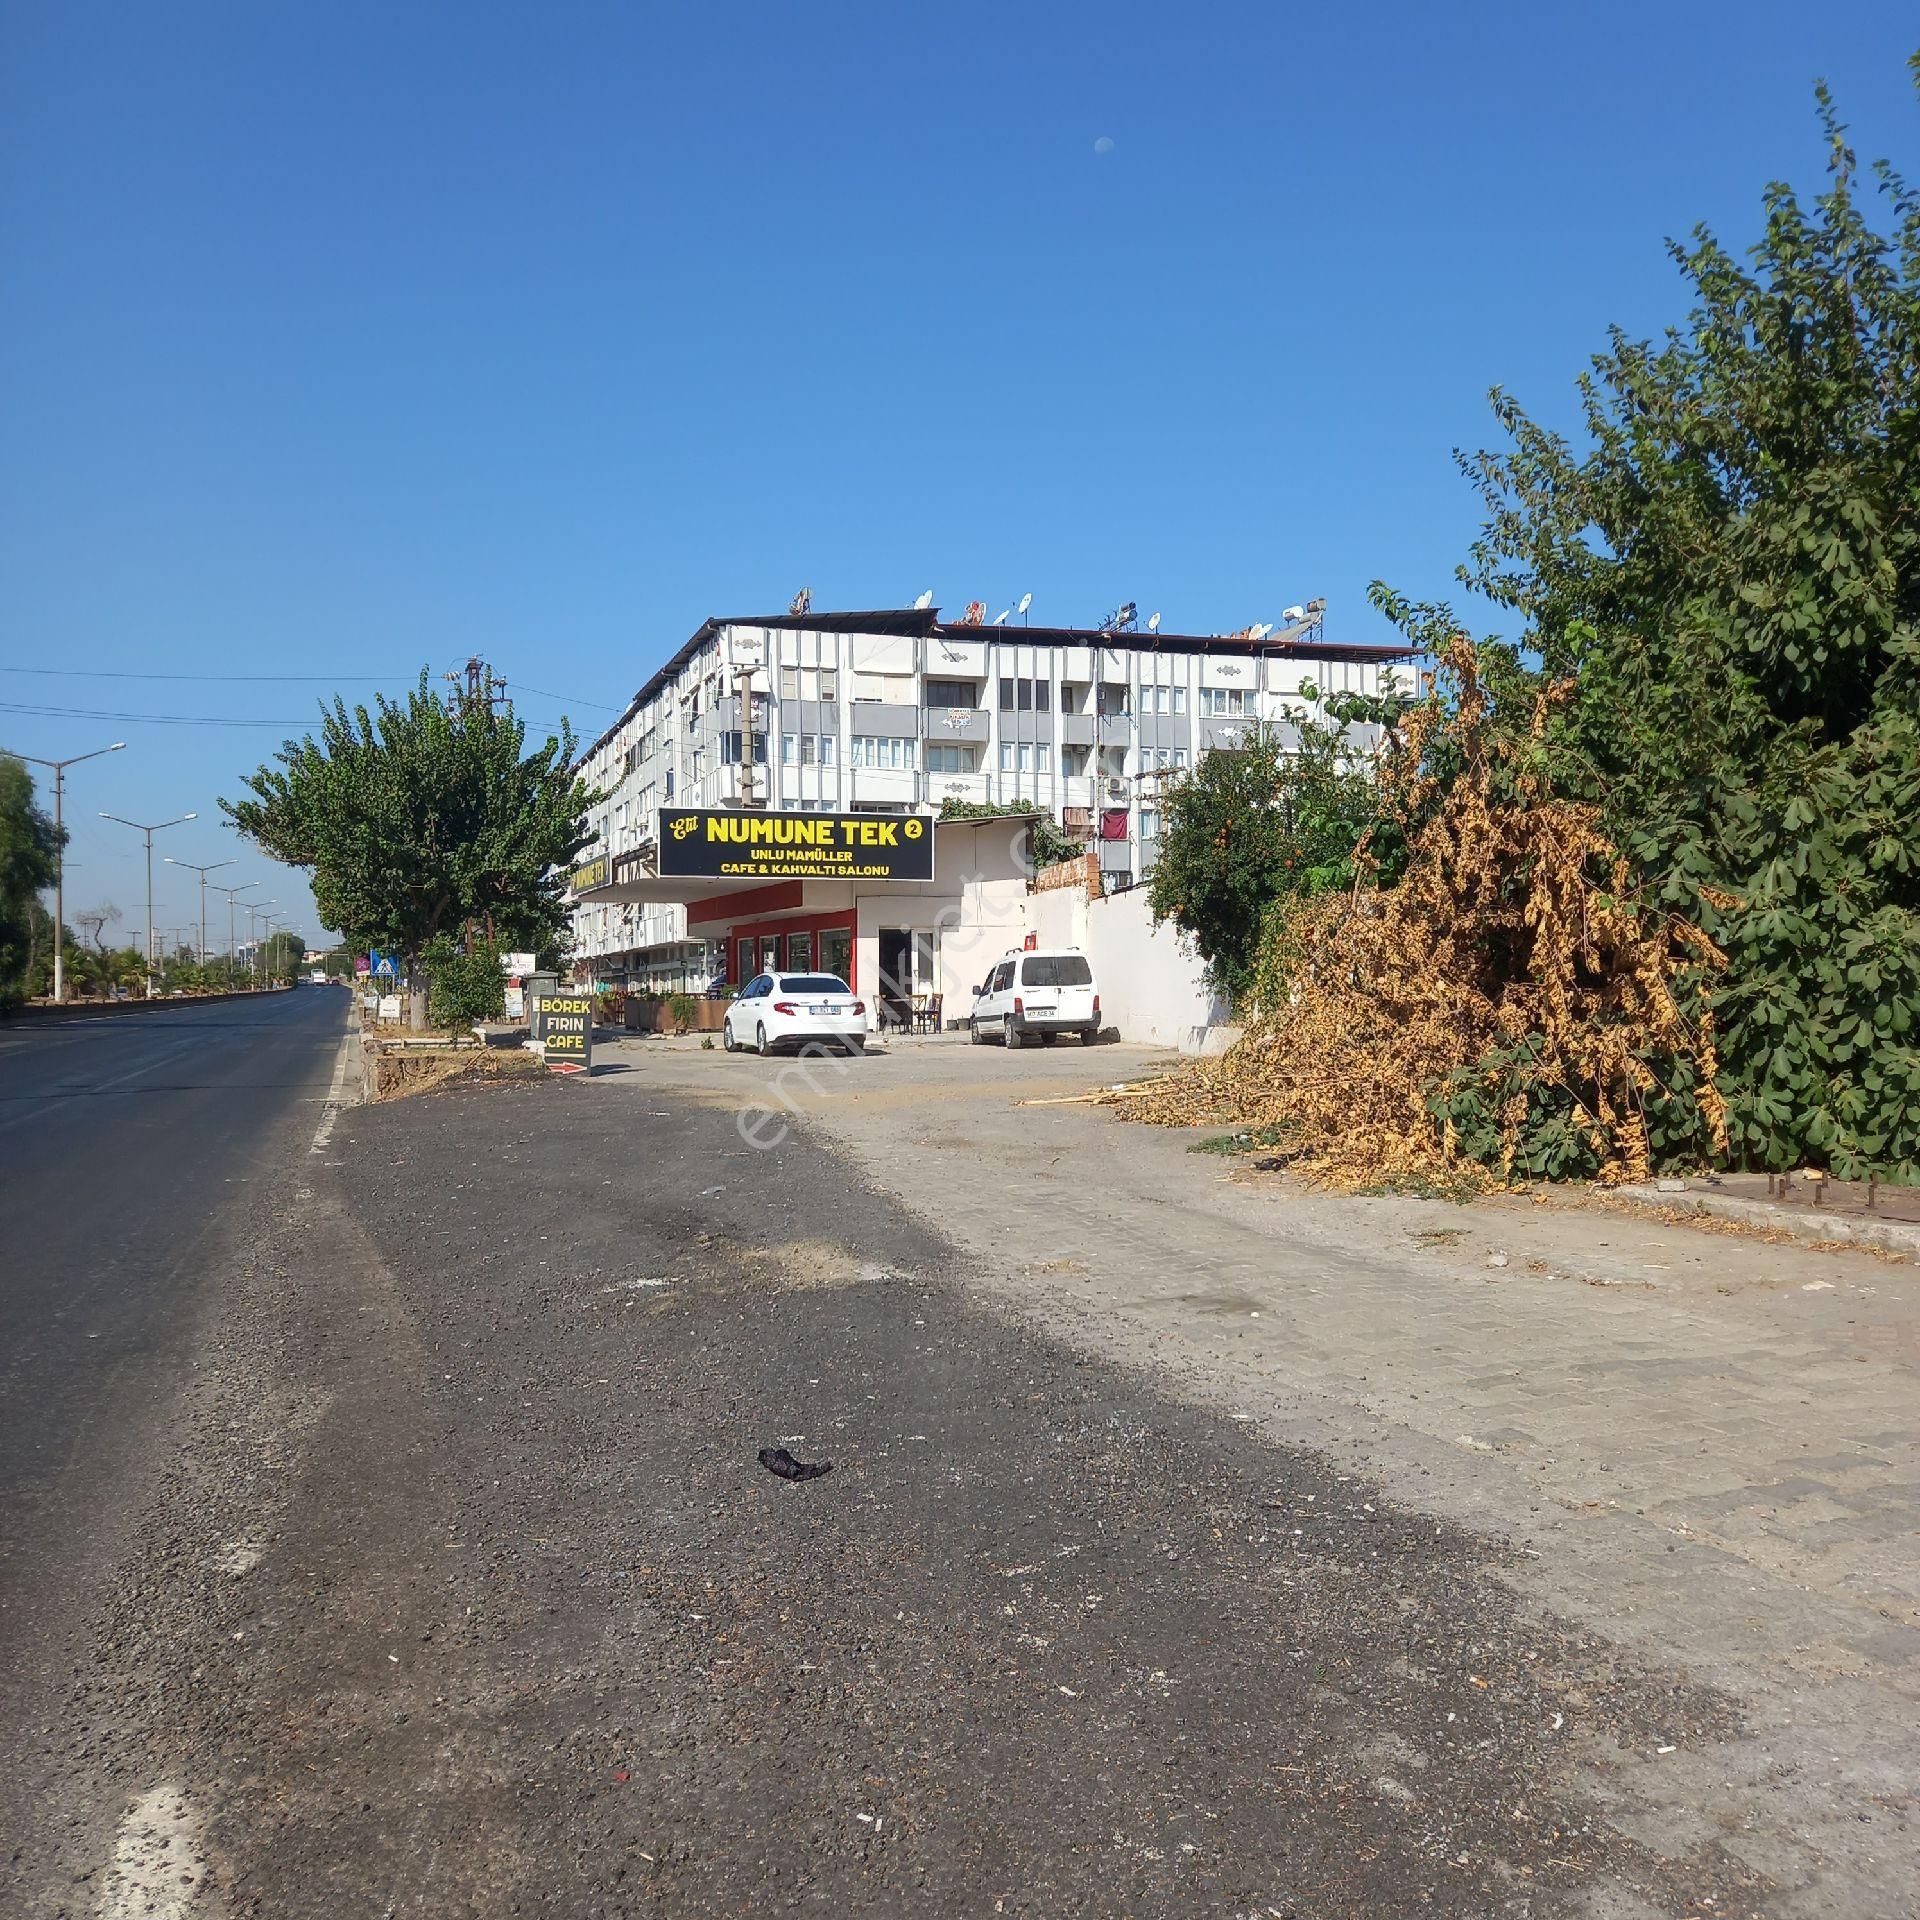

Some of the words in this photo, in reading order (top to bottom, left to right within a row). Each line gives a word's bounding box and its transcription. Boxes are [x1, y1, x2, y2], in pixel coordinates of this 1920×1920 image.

[669, 816, 699, 840] Elit
[707, 817, 835, 845] NUMUNE
[840, 821, 899, 846] TEK
[750, 849, 785, 860] UNLU
[786, 847, 853, 862] MAMÜLLER
[721, 863, 756, 874] CAFE
[758, 864, 769, 874] &
[771, 864, 835, 875] KAHVALTI
[837, 865, 890, 876] SALONU
[541, 997, 591, 1014] BÖREK
[547, 1017, 584, 1031] FIRIN
[546, 1034, 584, 1049] CAFE
